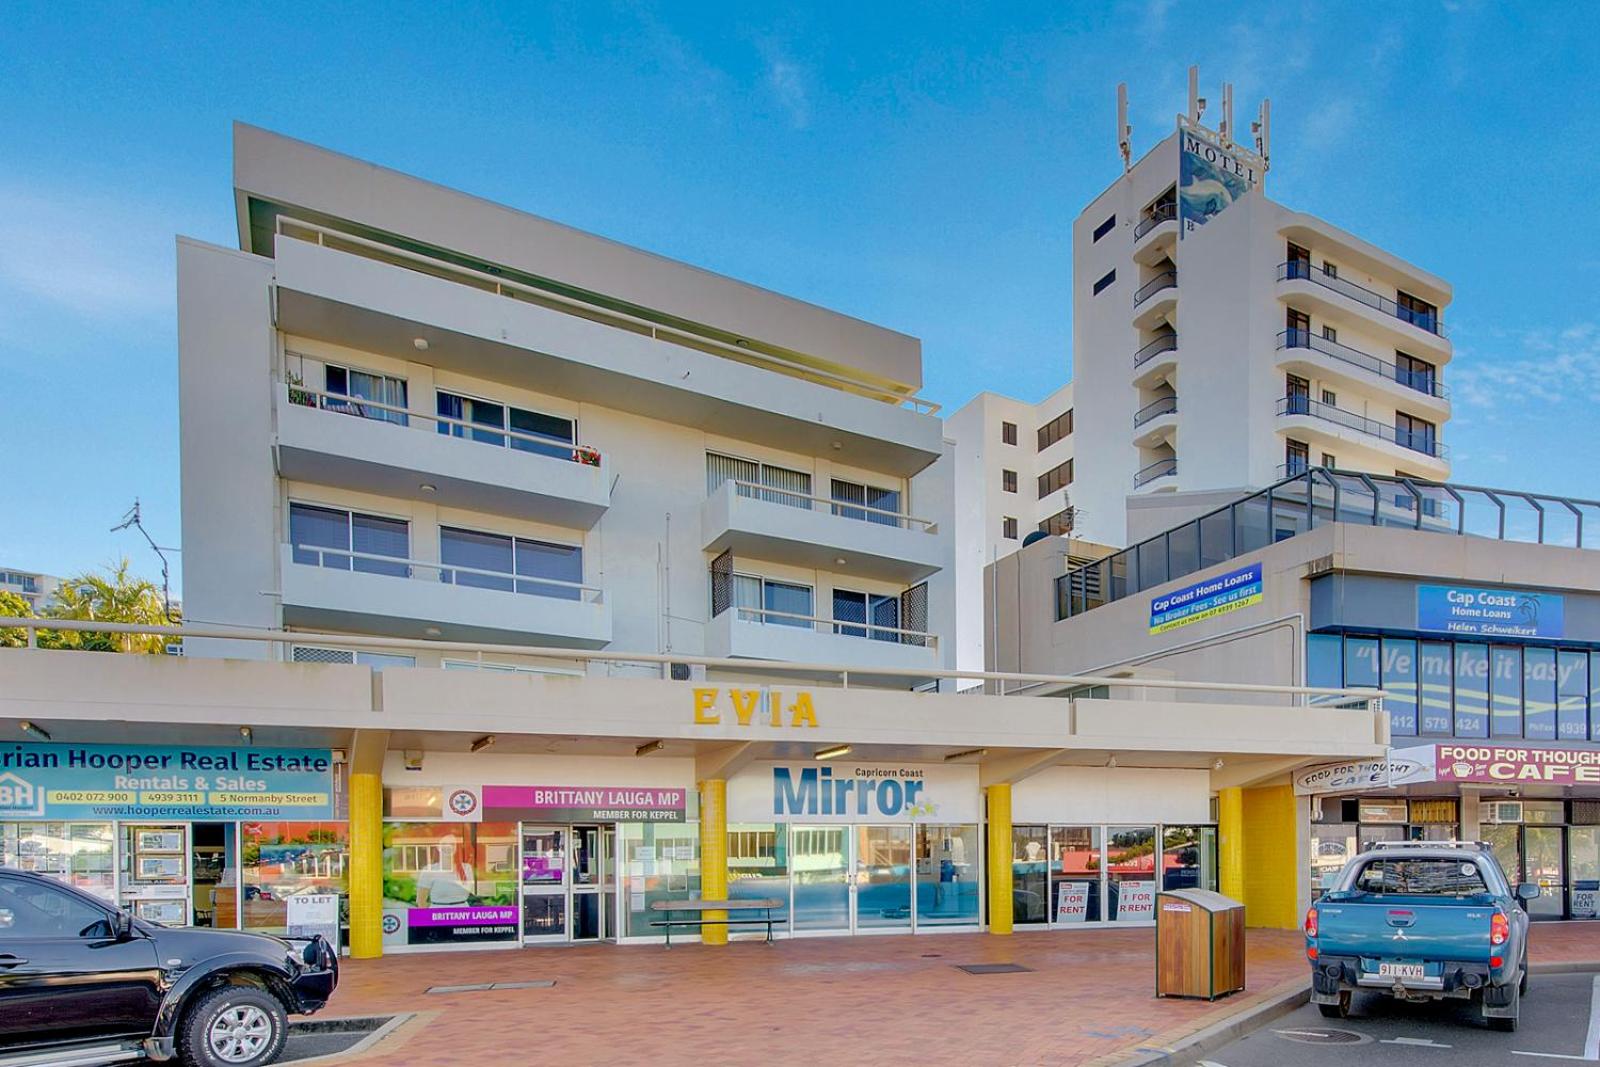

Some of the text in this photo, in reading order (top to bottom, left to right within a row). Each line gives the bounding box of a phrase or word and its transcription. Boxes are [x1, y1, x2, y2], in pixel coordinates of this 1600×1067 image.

[1186, 137, 1257, 184] MOTEL
[1153, 571, 1253, 611] Cap Coast Home Loans
[1213, 595, 1228, 606] See
[1447, 590, 1516, 607] Cap Coast
[1452, 606, 1512, 619] Home Loans
[1447, 622, 1477, 632] Helen
[1496, 654, 1514, 679] it
[693, 688, 819, 728] EVIA
[1391, 716, 1480, 733] 412 579 424
[0, 745, 328, 774] rian Hooper Real Estate
[1441, 747, 1600, 764] FOOD FOR THOUGH
[855, 767, 924, 778] Capricorn Coast
[1305, 770, 1331, 785] FOOD
[1489, 763, 1600, 782] CAFÉ
[115, 775, 267, 791] Rentals & Sales
[56, 792, 128, 801] 0402 072 900
[773, 767, 923, 816] Mirror
[148, 794, 198, 802] 4939 3111
[221, 794, 317, 804] 5 Normanby Street
[535, 790, 680, 806] BRITTANY LAUGA MP
[93, 804, 280, 817] www.hooperrealestate.com.au
[593, 810, 678, 820] MEMBER FOR KEPPEL
[312, 896, 332, 904] LET
[1065, 895, 1083, 903] FOR
[1576, 893, 1593, 901] FOR
[1060, 906, 1085, 914] RENT
[1128, 904, 1152, 912] RENT
[1573, 900, 1595, 908] RENT
[432, 911, 471, 921] BRITTANY
[472, 911, 498, 920] LAUGA
[453, 926, 515, 935] MEMBER FOR KEPPEL
